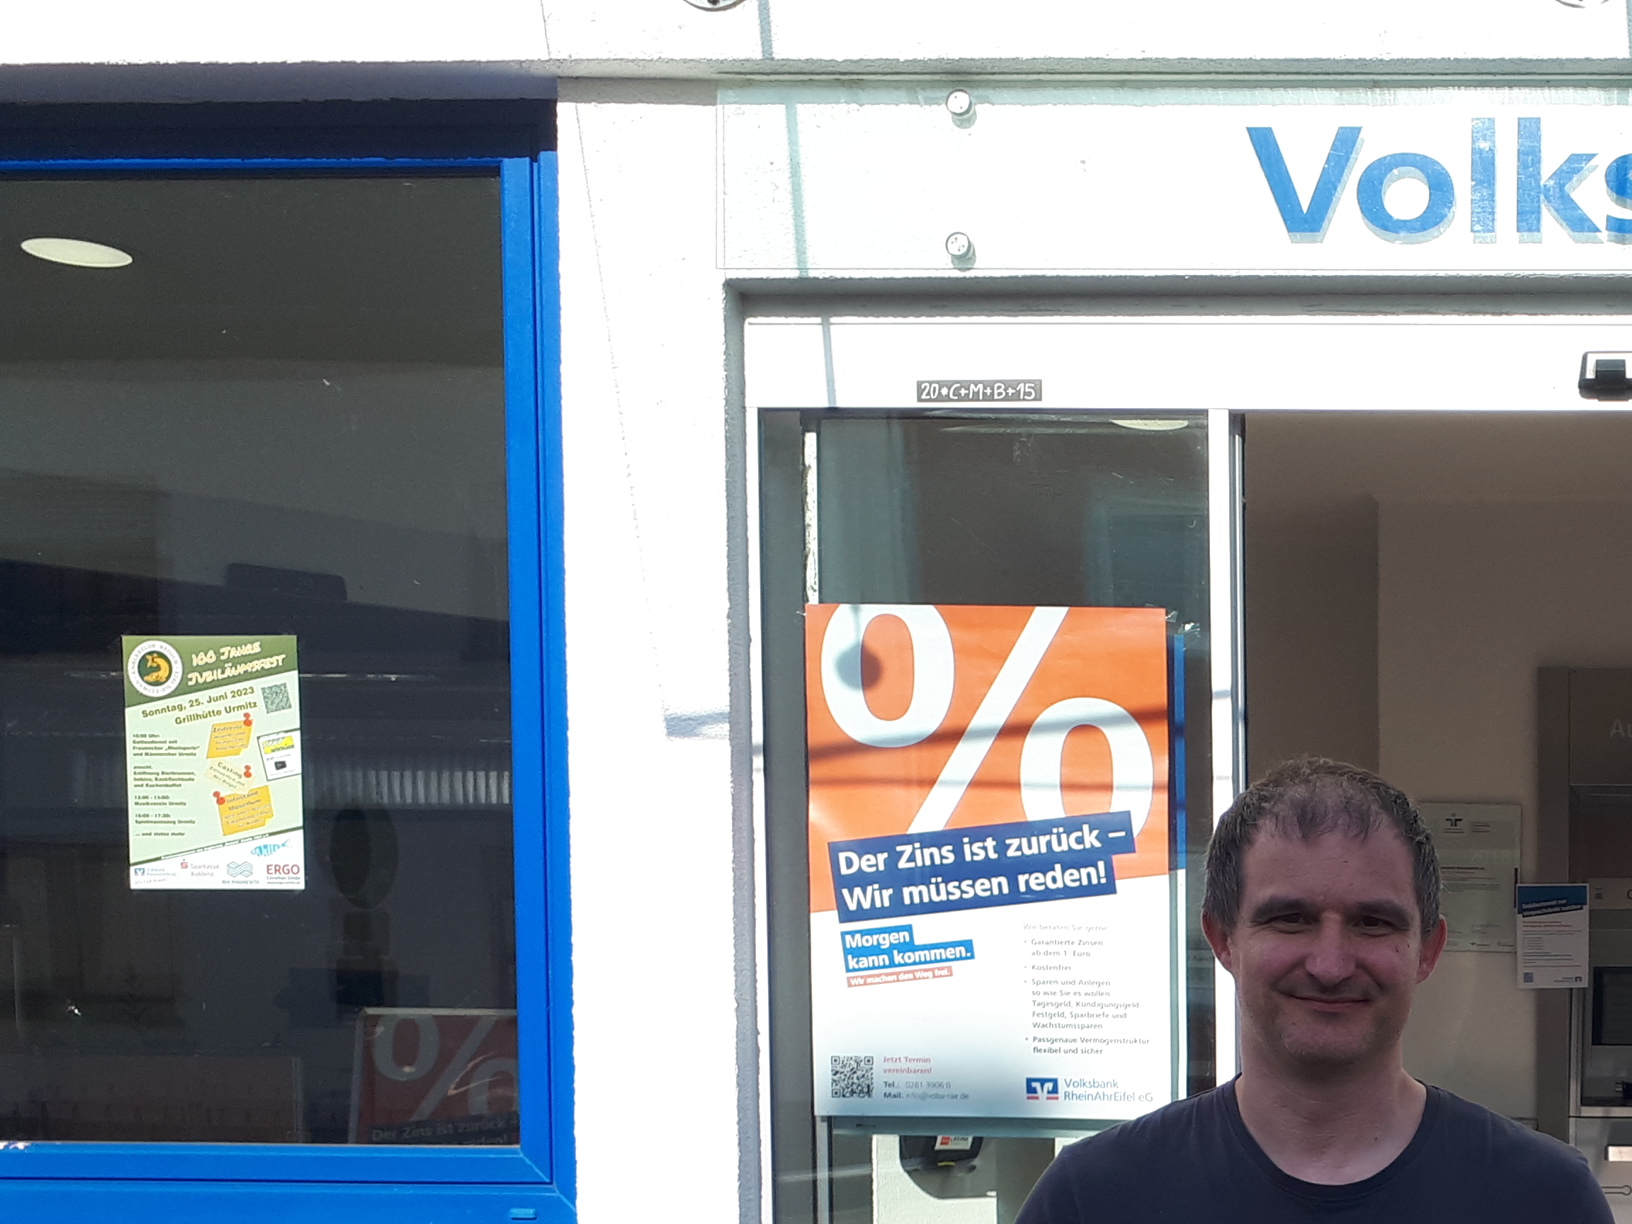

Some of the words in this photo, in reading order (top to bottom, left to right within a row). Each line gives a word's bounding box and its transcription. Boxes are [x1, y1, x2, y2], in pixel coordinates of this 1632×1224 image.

[142, 702, 186, 718] Sonntag,
[189, 697, 203, 708] 25.
[207, 692, 228, 704] Juni
[231, 686, 255, 699] 2023
[175, 710, 222, 725] Grillhütte
[225, 701, 258, 714] Urmitz
[838, 850, 888, 875] Der
[896, 842, 955, 869] Zins
[963, 837, 998, 861] ist
[1005, 824, 1101, 857] zurück
[266, 864, 300, 875] ERGO
[842, 884, 893, 911] Wir
[902, 875, 1009, 904] müssen
[1018, 861, 1107, 892] reden!
[845, 929, 910, 950] Morgen
[847, 951, 890, 970] kann
[894, 945, 971, 965] kommen.
[850, 977, 864, 986] Wir
[866, 974, 897, 984] machen
[899, 972, 912, 981] den
[914, 970, 933, 981] Weg
[934, 969, 950, 978] frei.
[1031, 979, 1058, 987] Sparen
[1069, 1011, 1110, 1019] Sparbriefe
[1032, 1022, 1103, 1030] Wachstumssparen
[1032, 1036, 1078, 1045] Passgenaue
[1080, 1047, 1103, 1055] sicher
[883, 1056, 902, 1064] Jetzt
[904, 1056, 931, 1064] Termin
[1064, 1079, 1119, 1089] Volksbank
[1064, 1091, 1135, 1102] RheinAhrEifel
[1138, 1093, 1153, 1102] eG
